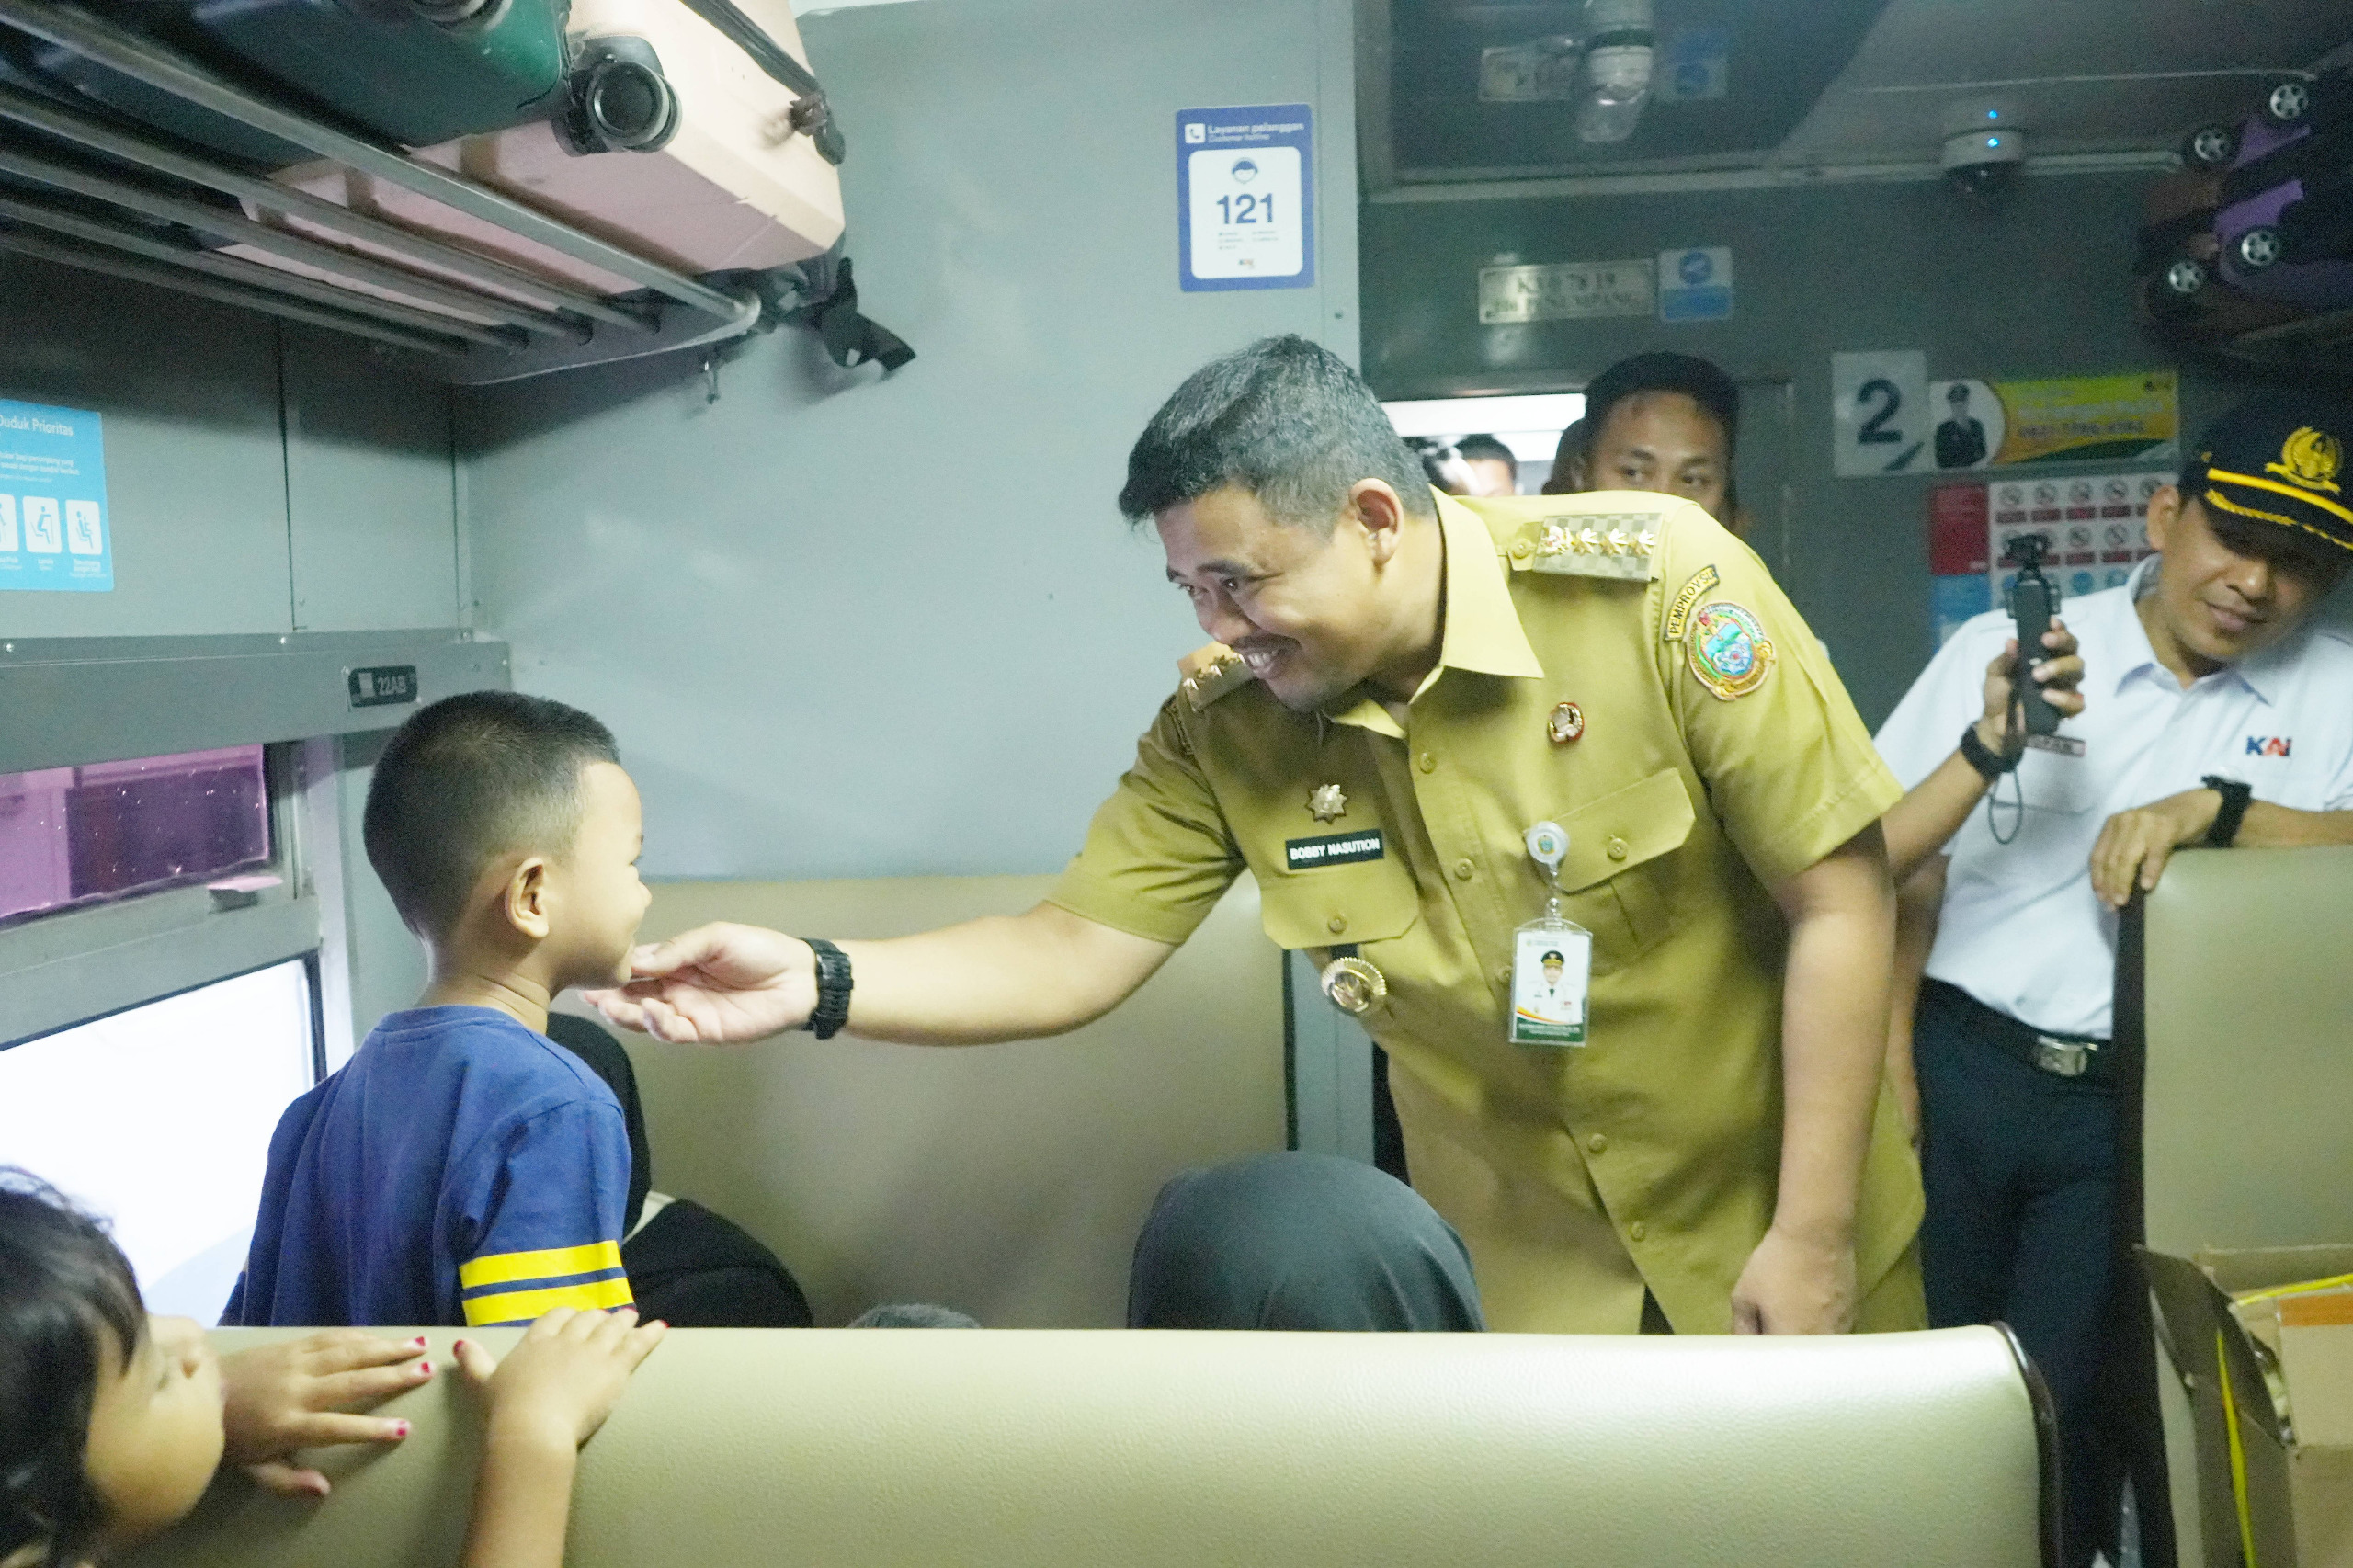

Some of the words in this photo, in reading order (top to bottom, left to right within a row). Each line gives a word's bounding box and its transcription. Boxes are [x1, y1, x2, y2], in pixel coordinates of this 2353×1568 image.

[1216, 193, 1274, 224] 121
[1857, 378, 1903, 445] 2
[32, 418, 74, 437] Prioritas
[1290, 845, 1325, 860] BOBBY
[1327, 837, 1381, 856] NASUTION
